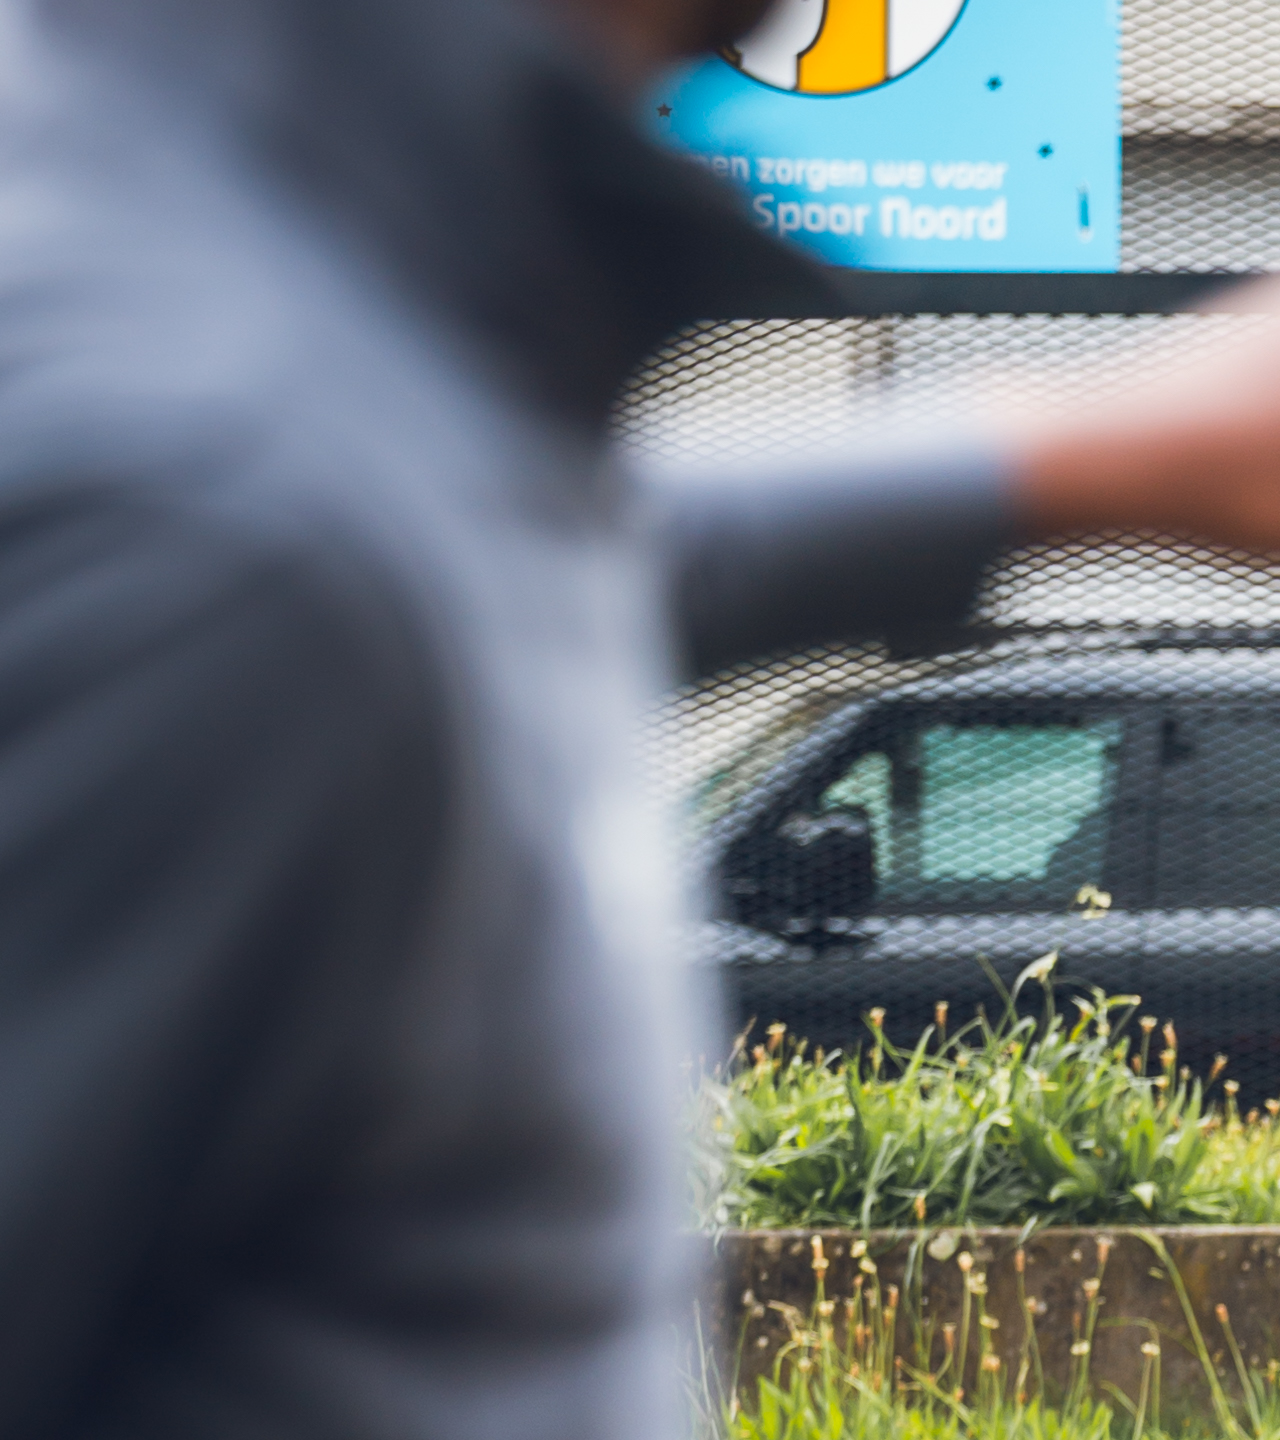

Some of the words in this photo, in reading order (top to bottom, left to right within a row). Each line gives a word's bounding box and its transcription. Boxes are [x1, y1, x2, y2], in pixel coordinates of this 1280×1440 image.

[756, 157, 868, 193] zorgen
[872, 160, 926, 190] we
[930, 161, 1008, 191] voor
[753, 192, 871, 238] Spoor
